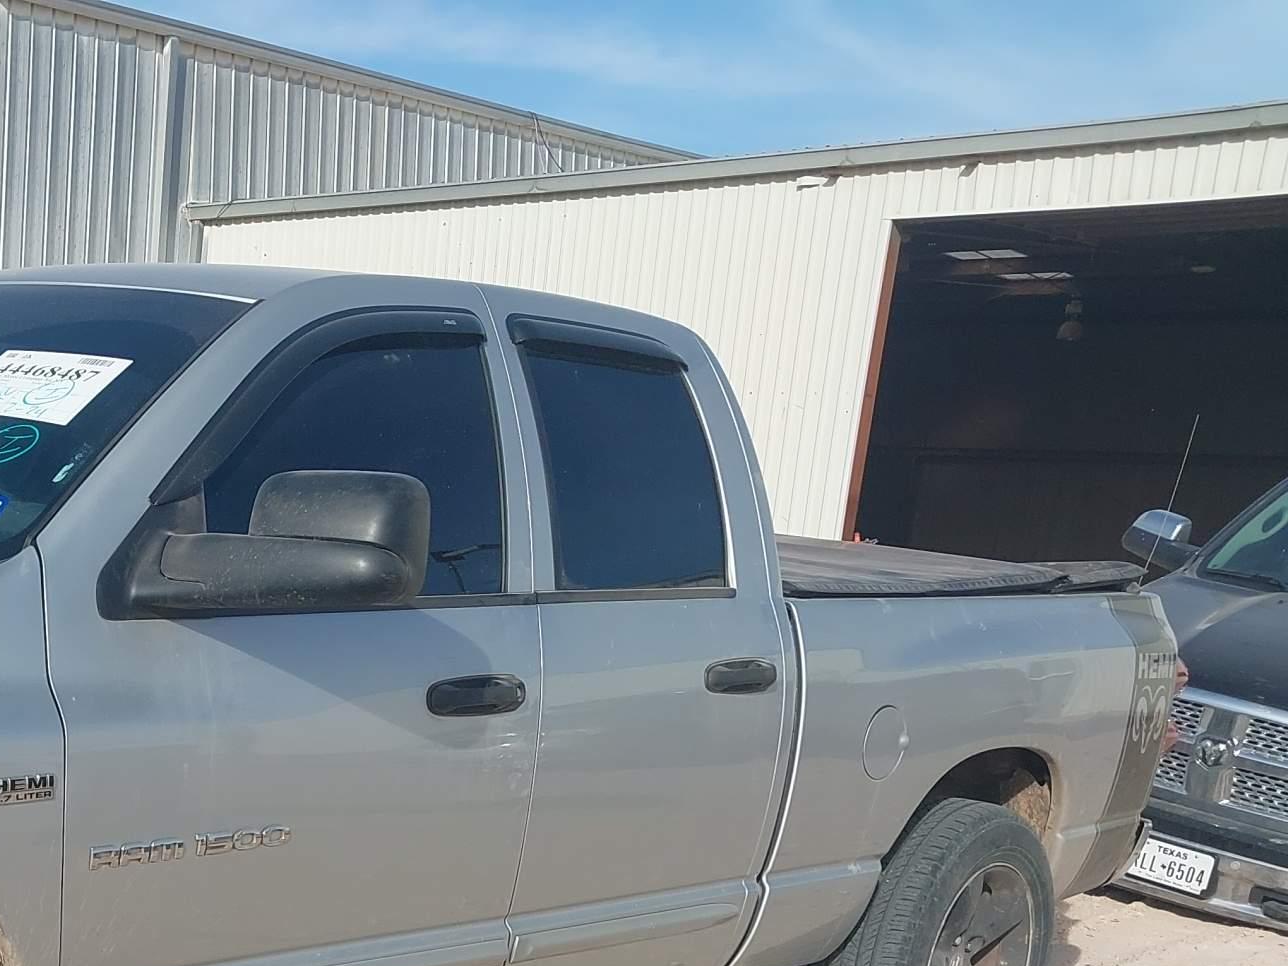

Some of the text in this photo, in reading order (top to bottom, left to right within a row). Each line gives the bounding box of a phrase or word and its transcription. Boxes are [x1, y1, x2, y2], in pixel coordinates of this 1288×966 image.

[16, 790, 52, 801] LITER
[89, 824, 292, 872] RAM 1500
[1157, 845, 1189, 860] TEXAS
[1166, 860, 1205, 887] 6504
